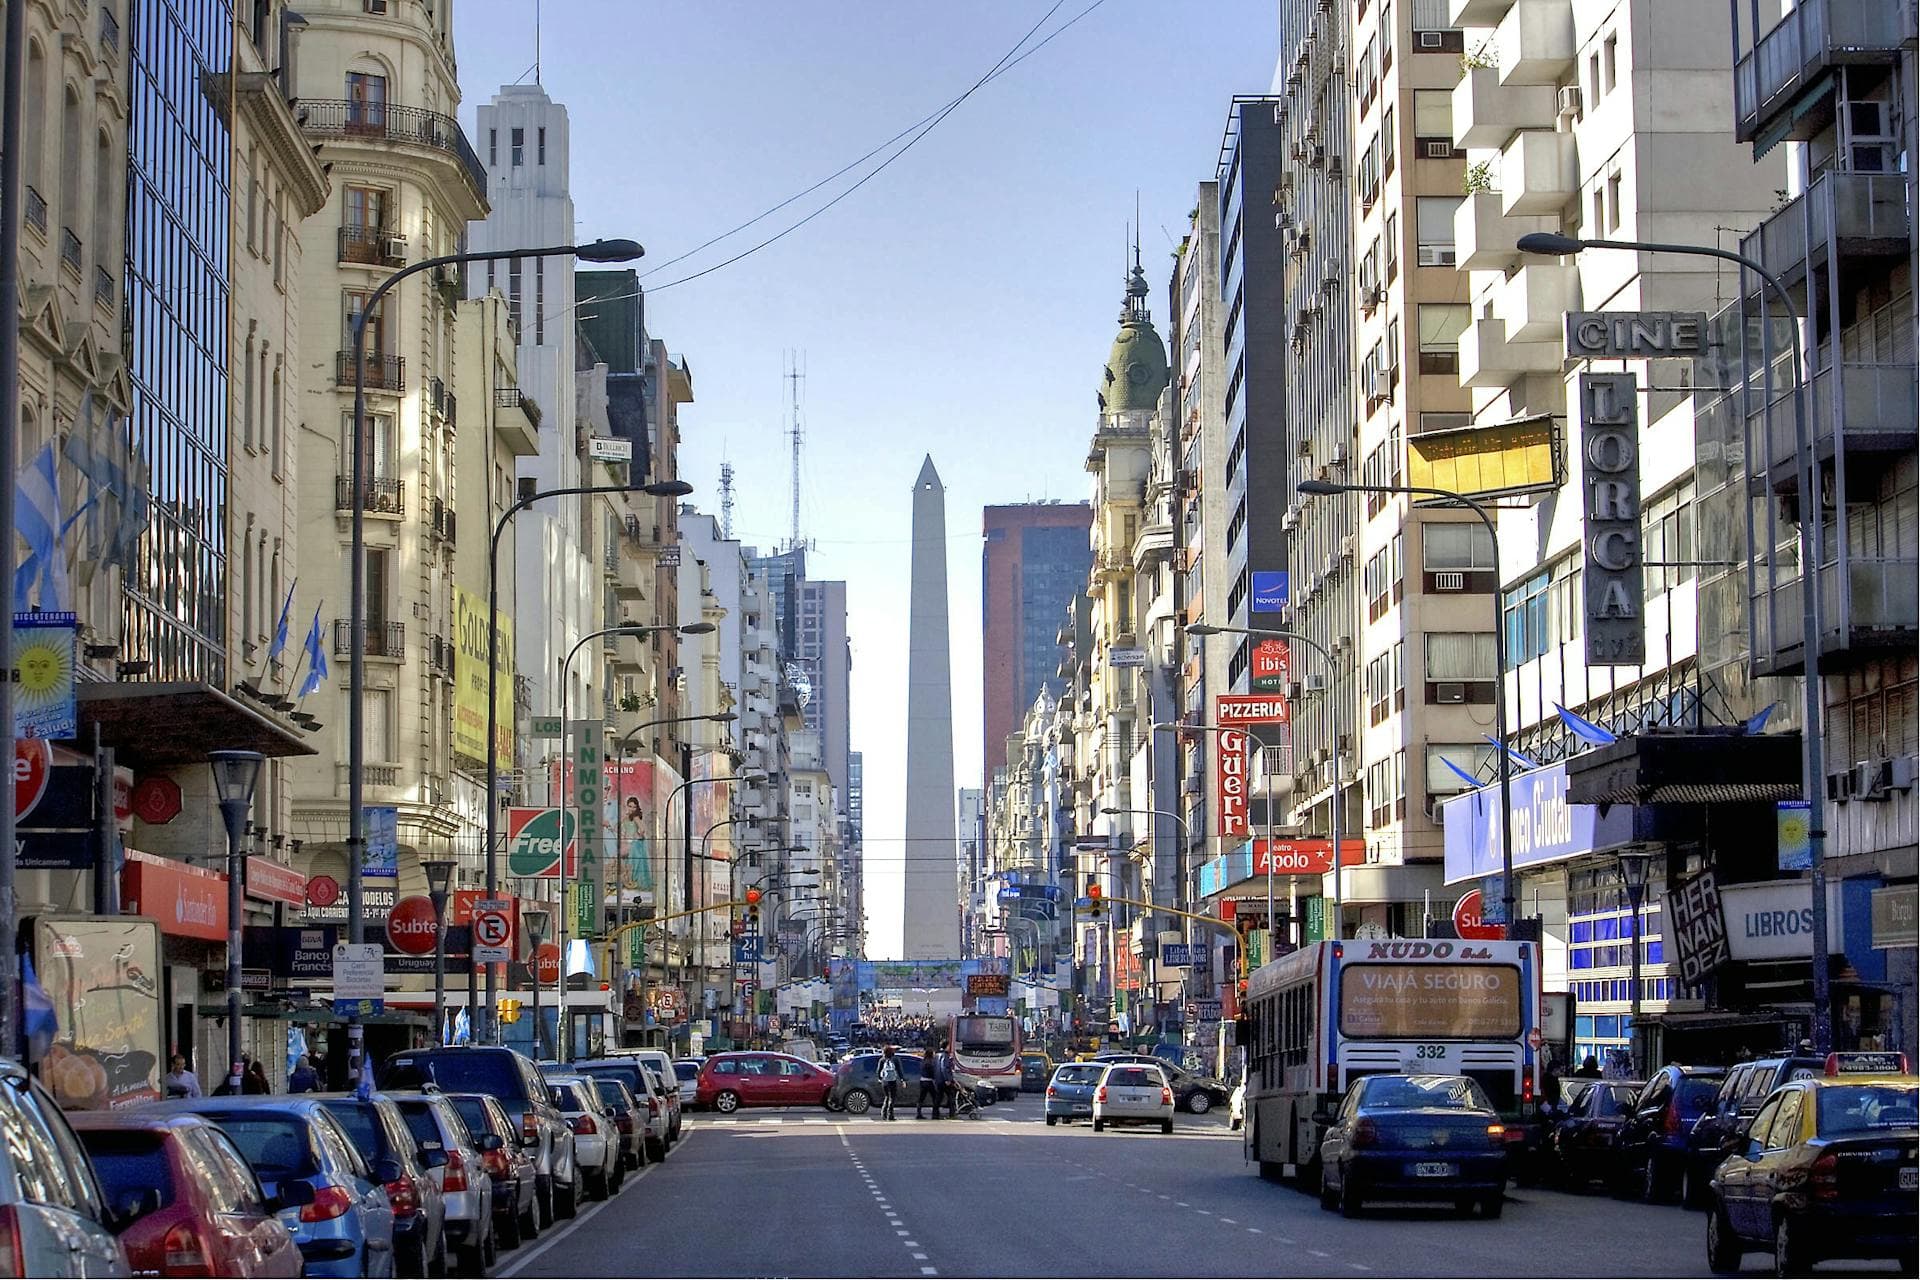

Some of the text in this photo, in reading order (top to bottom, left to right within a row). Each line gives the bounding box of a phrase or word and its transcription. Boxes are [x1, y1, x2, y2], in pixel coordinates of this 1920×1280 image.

[1577, 317, 1699, 350] CINE
[1587, 381, 1640, 618] LORCA
[458, 593, 510, 676] GOLDSEIN
[1260, 657, 1287, 671] ibis
[1220, 702, 1284, 718] PIZZERIA
[535, 721, 562, 733] LOS
[579, 728, 597, 883] INMORTAL
[1533, 776, 1572, 848] Ciudad
[511, 833, 562, 854] Free
[1260, 849, 1309, 873] Apolo
[362, 891, 394, 906] ODELOS
[321, 907, 349, 918] CORRIENT
[392, 918, 439, 934] Subte
[1744, 907, 1814, 938] LIBROS
[294, 950, 330, 961] Banco
[1368, 942, 1454, 959] NUDO
[291, 960, 333, 972] Francés
[398, 958, 436, 969] Uruguay
[538, 955, 560, 969] ubte
[1362, 970, 1500, 993] VIAJÁ SEGURO
[1416, 1045, 1446, 1059] 332
